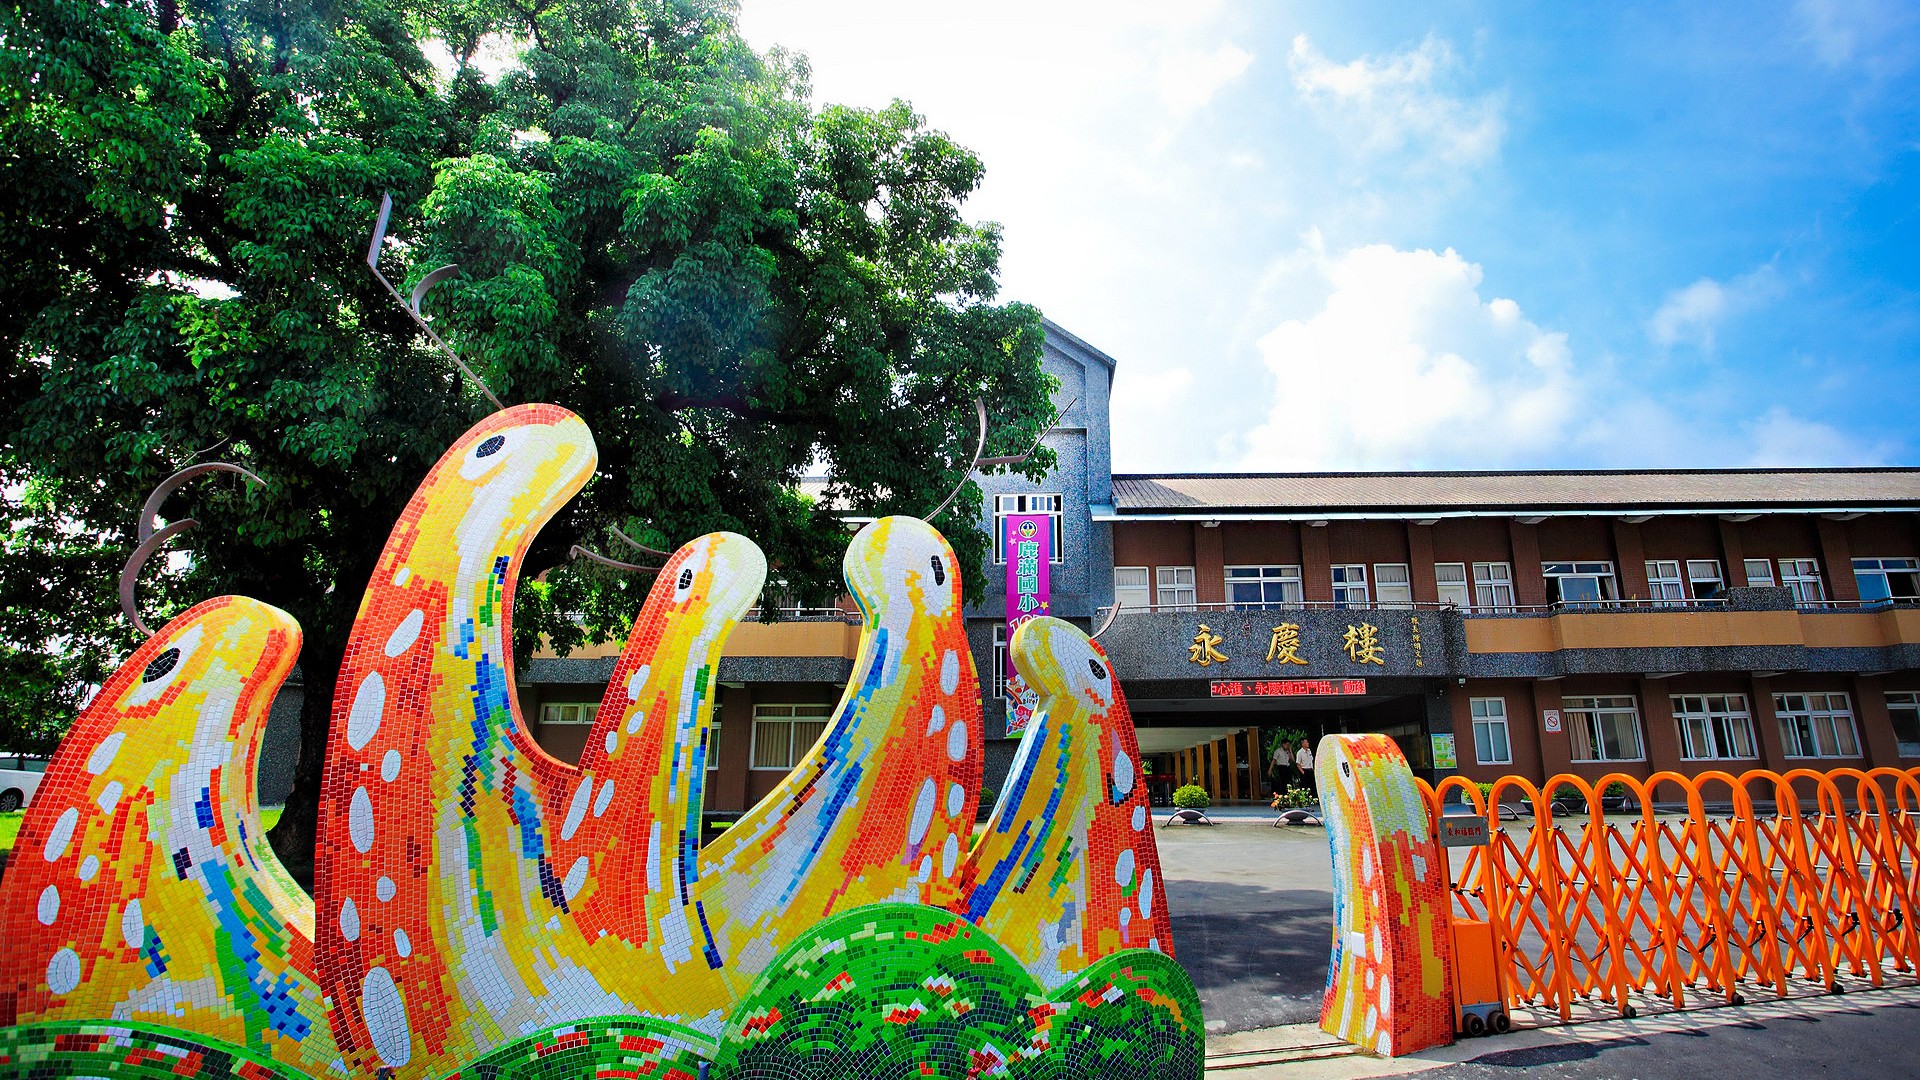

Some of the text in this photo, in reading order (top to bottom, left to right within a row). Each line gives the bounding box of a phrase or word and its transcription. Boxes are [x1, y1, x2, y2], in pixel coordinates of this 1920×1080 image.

[1016, 540, 1040, 612] 鹿滿國小
[1188, 622, 1385, 667] 永慶樓
